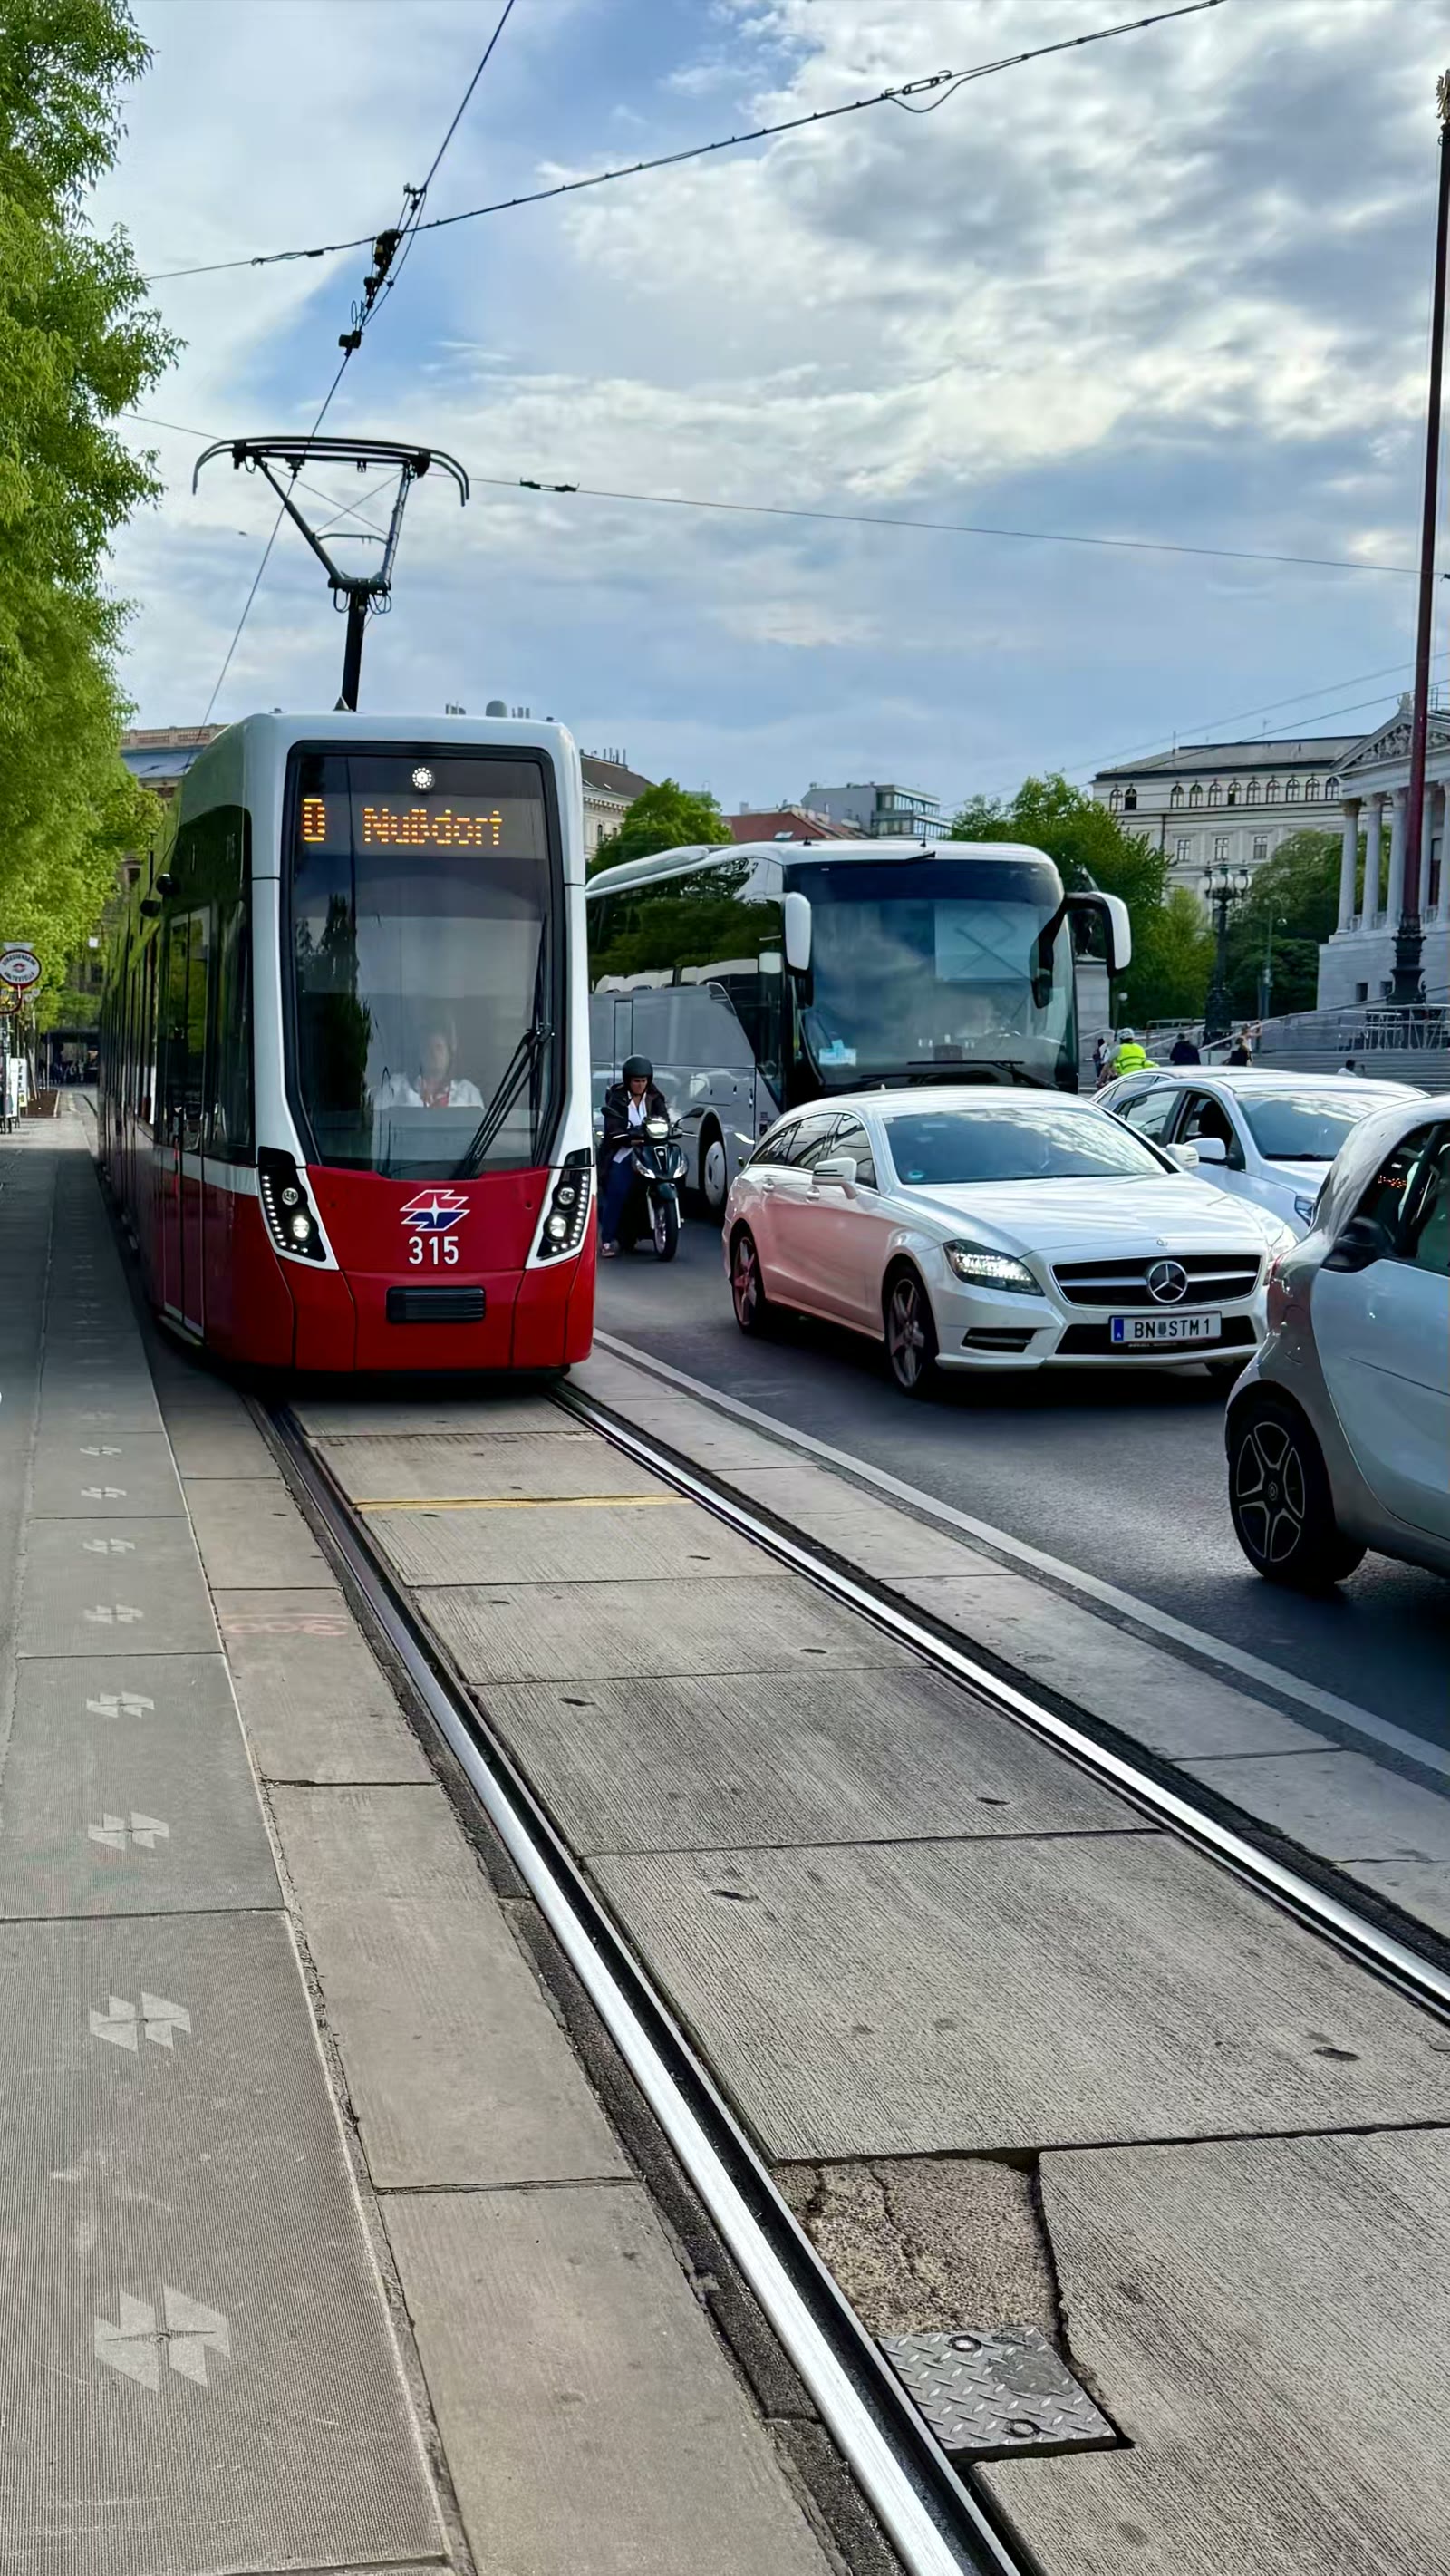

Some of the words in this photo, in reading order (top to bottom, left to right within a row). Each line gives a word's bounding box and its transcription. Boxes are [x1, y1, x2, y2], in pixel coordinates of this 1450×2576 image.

[304, 798, 325, 842] D
[408, 1235, 459, 1265] 315
[1134, 1321, 1156, 1339] BN
[1168, 1319, 1199, 1337] STM
[1203, 1317, 1210, 1335] 1
